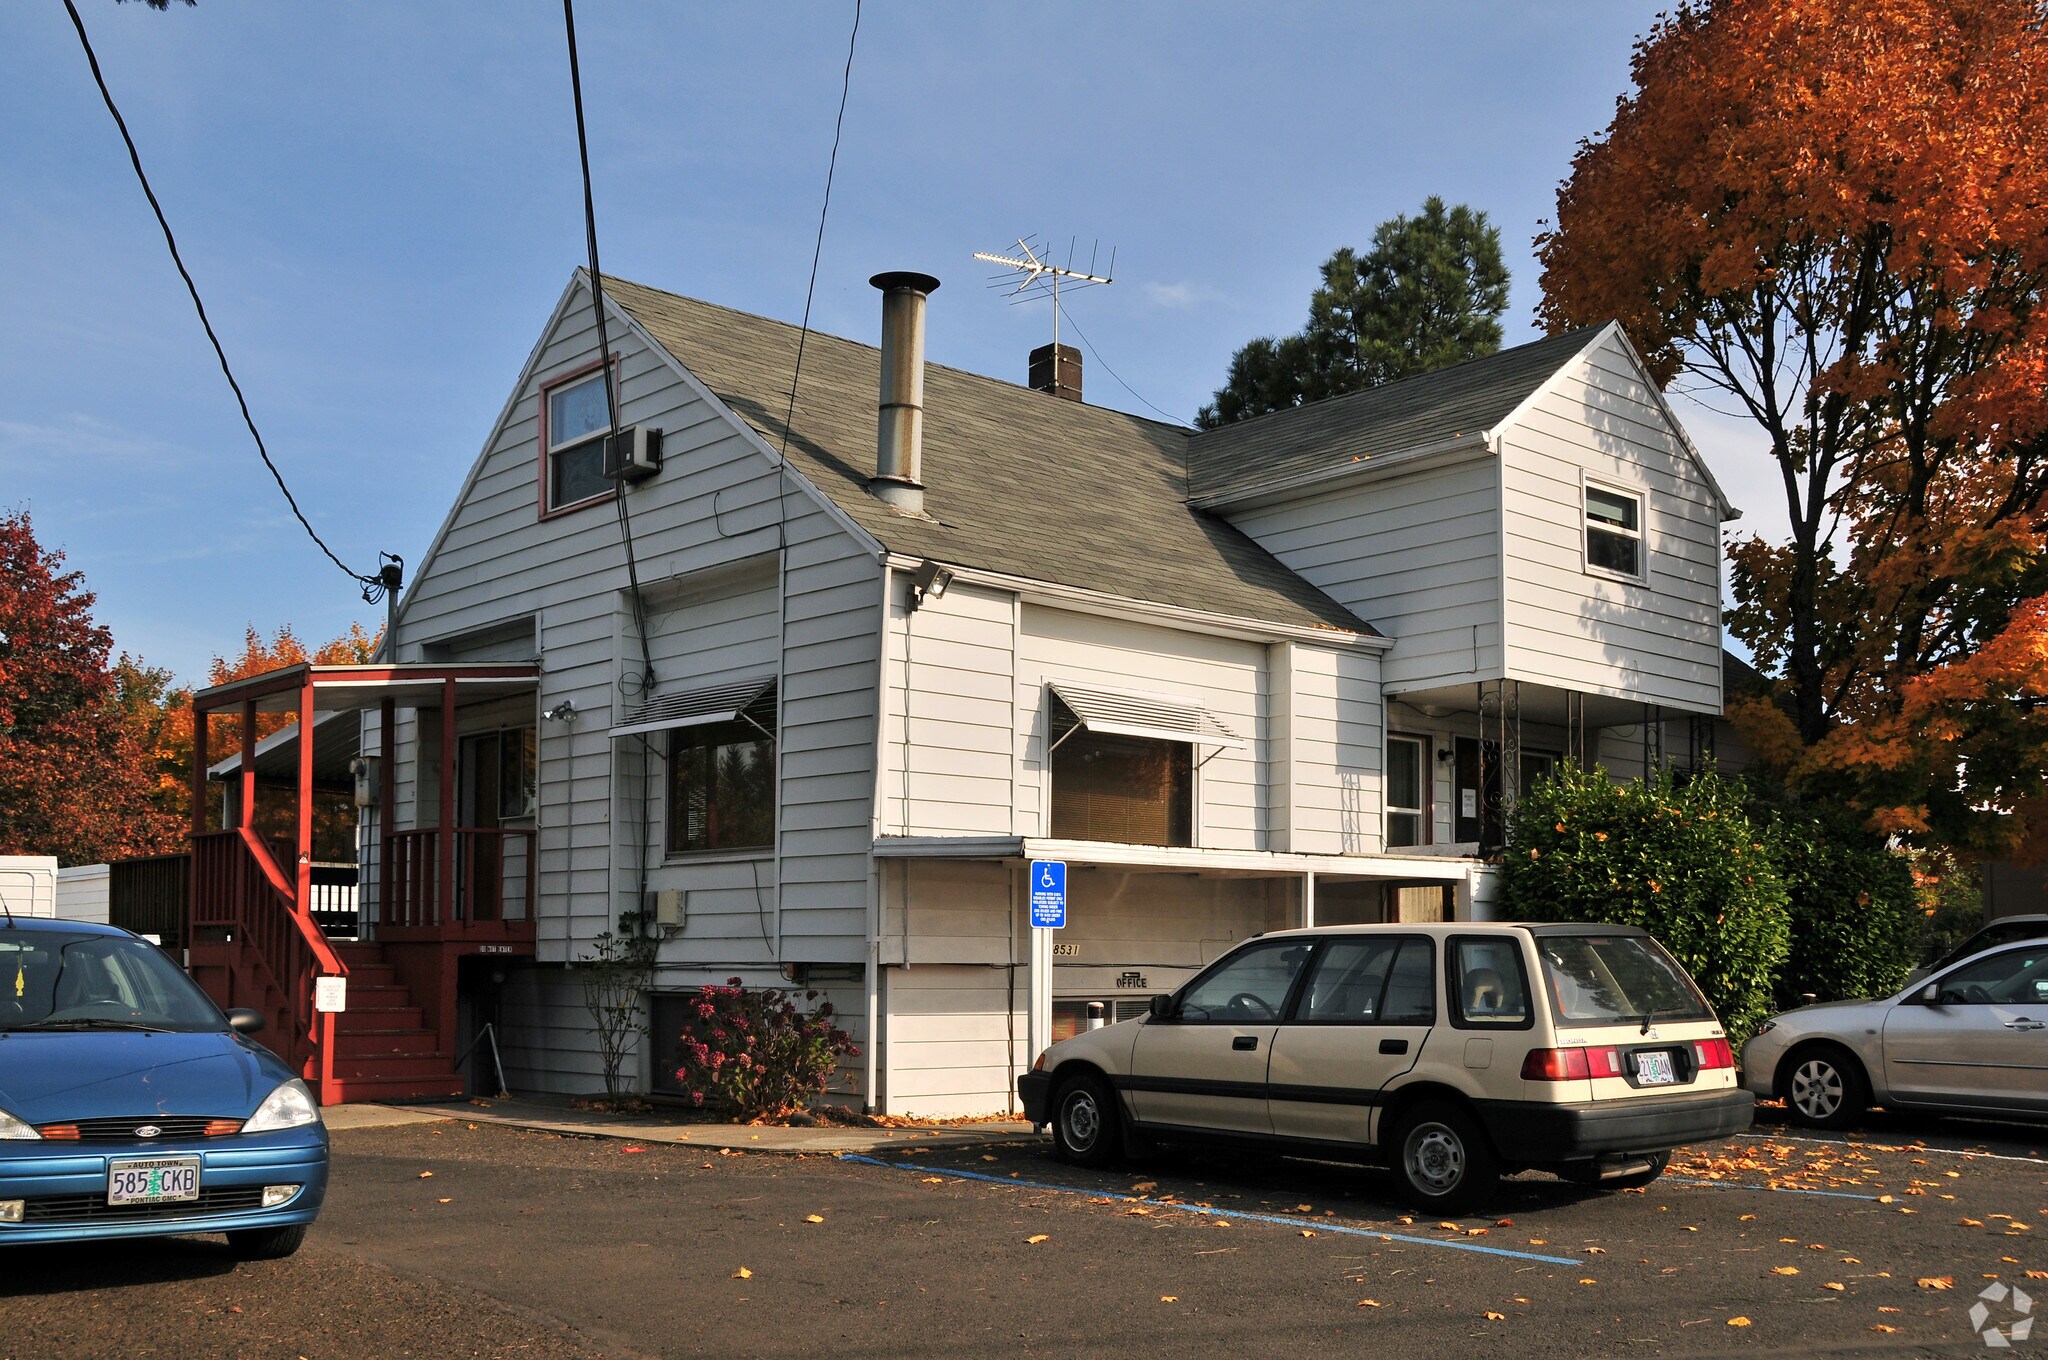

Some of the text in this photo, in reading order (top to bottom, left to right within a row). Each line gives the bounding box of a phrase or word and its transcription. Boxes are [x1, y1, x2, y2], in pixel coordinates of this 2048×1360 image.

[1053, 944, 1078, 956] 8531
[1116, 978, 1147, 988] OFFICE
[1654, 1058, 1671, 1076] DAN
[114, 1169, 194, 1194] 585 CKB
